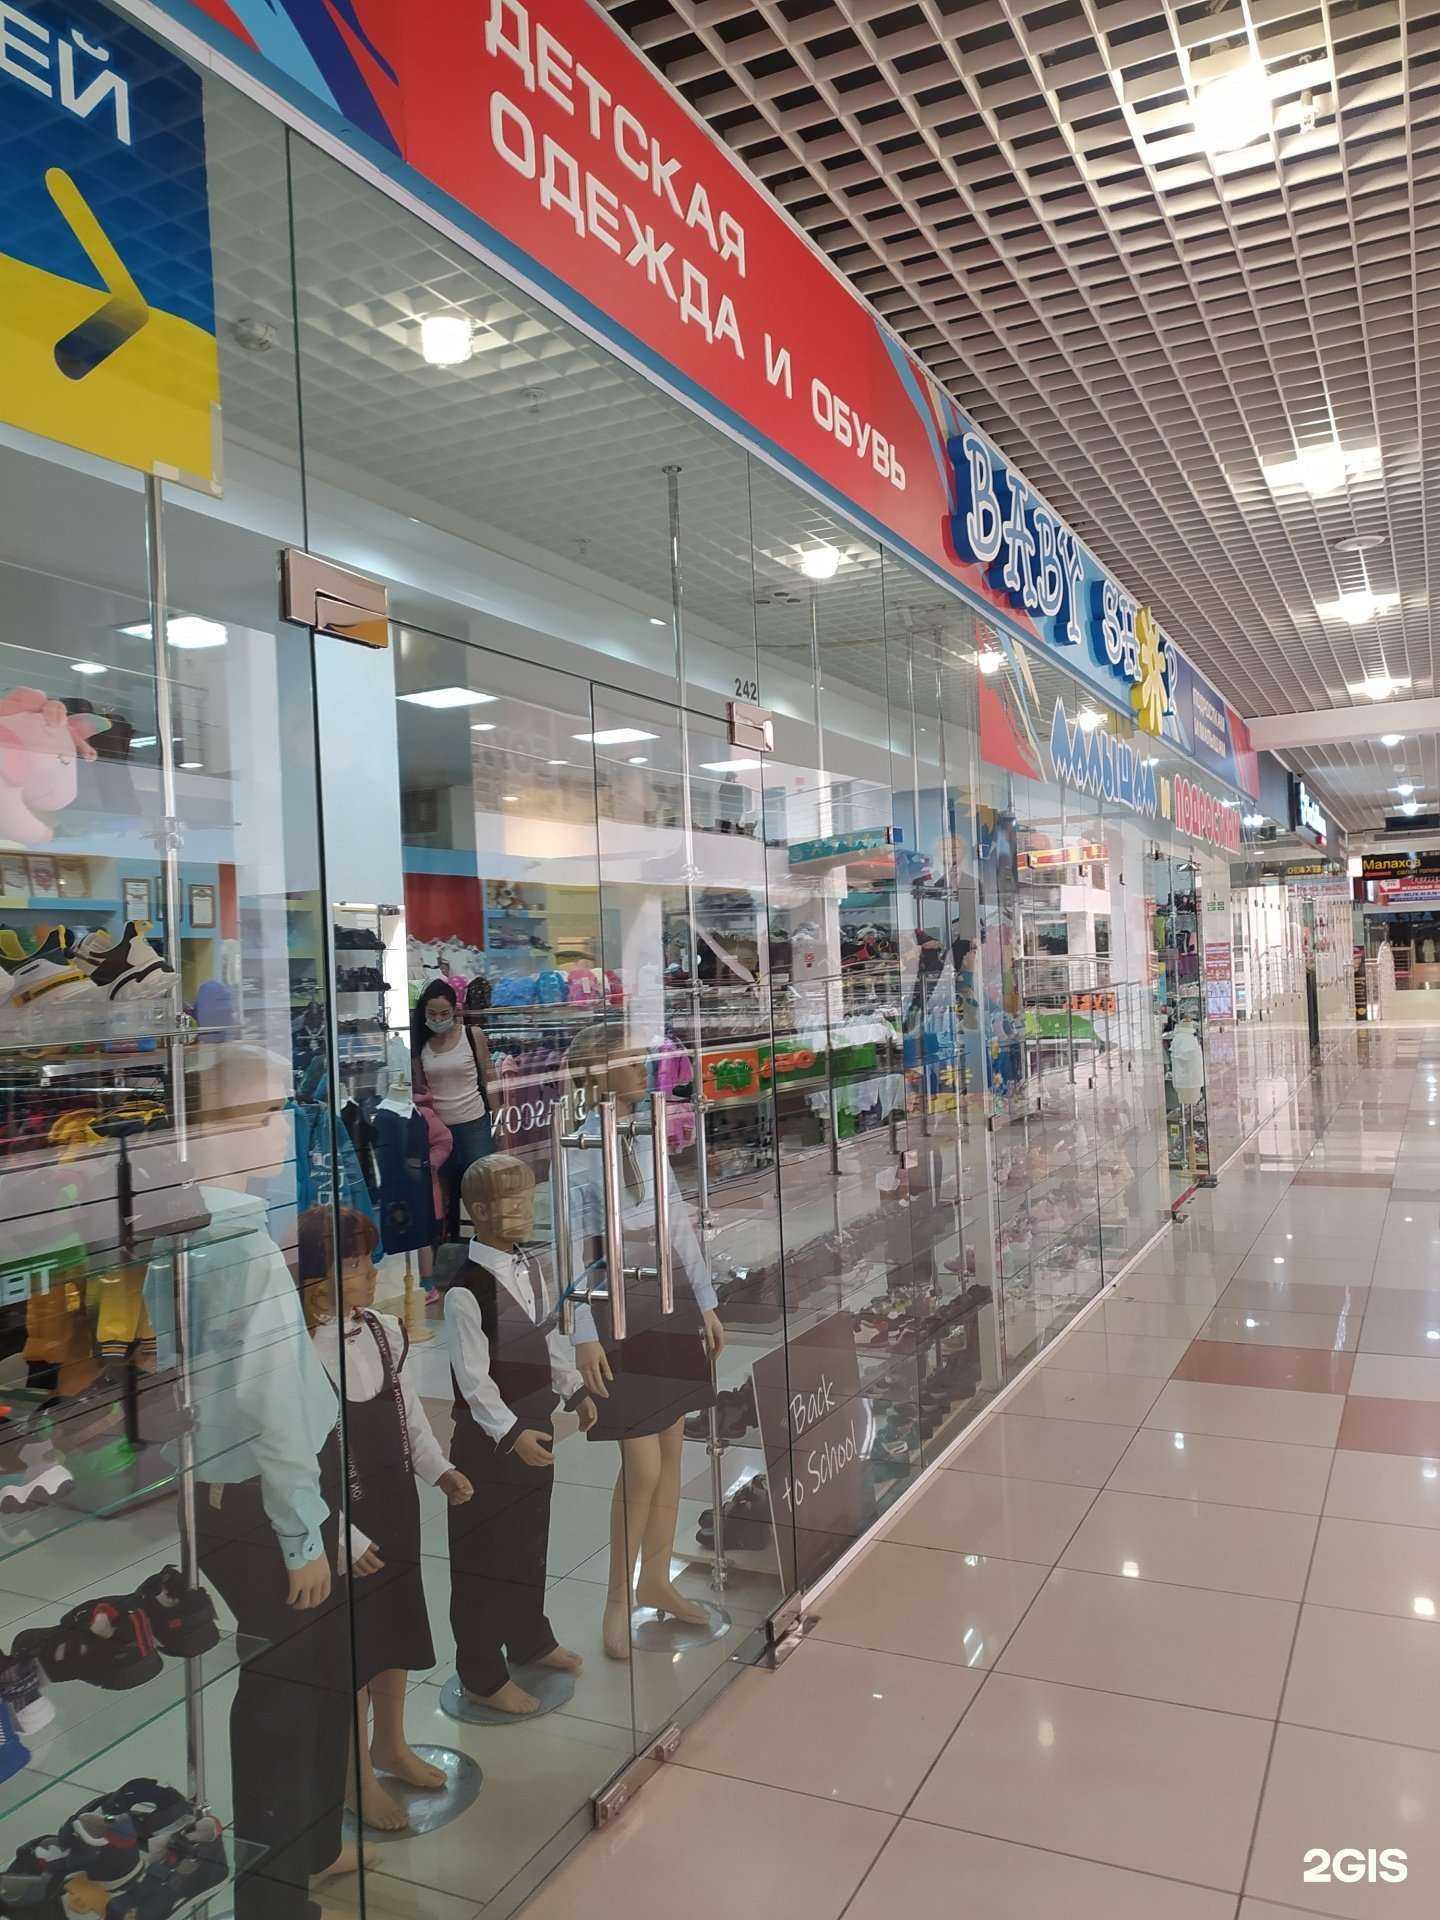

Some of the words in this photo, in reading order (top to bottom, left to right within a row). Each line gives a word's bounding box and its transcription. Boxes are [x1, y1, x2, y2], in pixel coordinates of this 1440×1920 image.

[485, 0, 746, 278] ДЕТСКАЯ
[490, 91, 745, 360] ОДЕЖДА
[764, 333, 793, 399] И
[811, 378, 906, 491] ОБУВЬ
[962, 431, 1084, 646] BABY
[1102, 579, 1178, 716] SHP
[735, 677, 757, 700] 242
[1363, 858, 1422, 870] Малахов
[789, 1373, 835, 1434] Back
[782, 1477, 804, 1513] to
[807, 1419, 857, 1493] School
